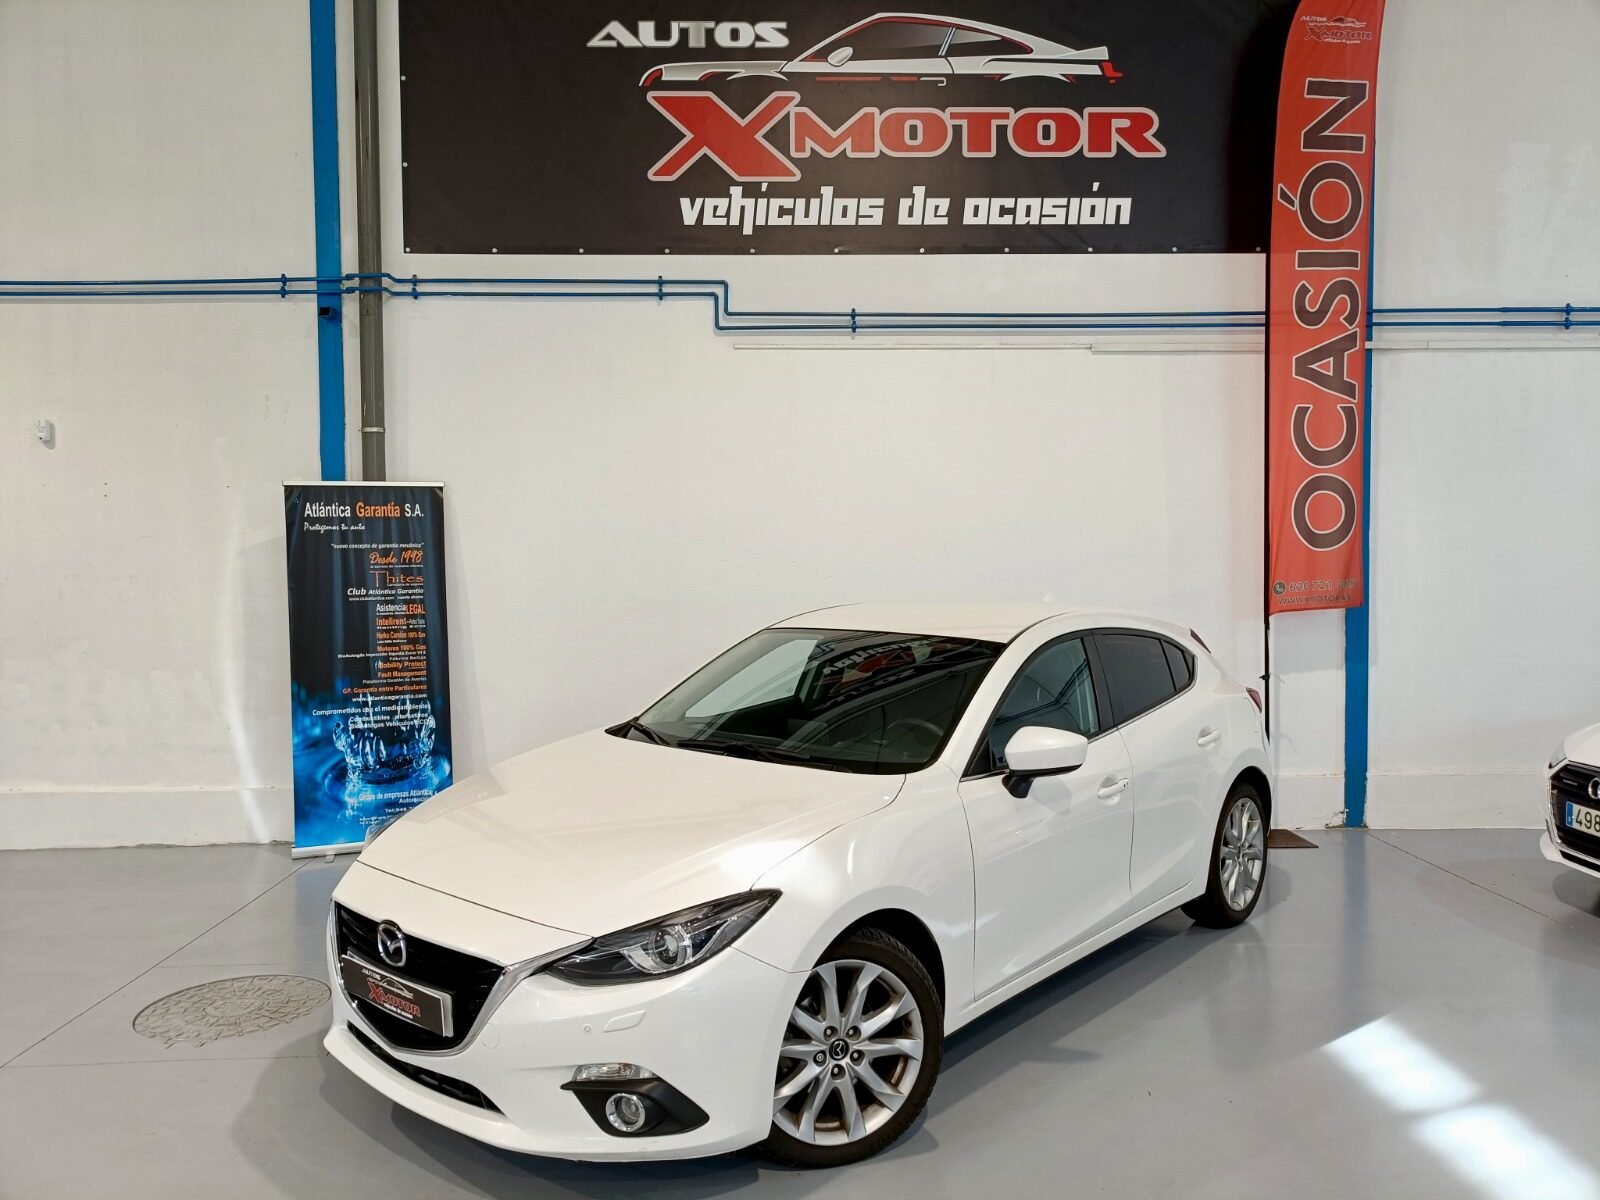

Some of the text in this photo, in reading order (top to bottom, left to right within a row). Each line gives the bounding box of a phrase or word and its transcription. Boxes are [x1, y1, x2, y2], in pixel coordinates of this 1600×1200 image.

[586, 20, 790, 48] AUTOS
[647, 91, 1167, 182] XMOTOR
[680, 182, 1132, 235] vehículos de ocasión
[1278, 78, 1369, 552] OCASIÓN
[304, 502, 424, 518] Atlántica Garantía S.A.
[304, 522, 366, 534] Protegemos tu auto
[369, 550, 423, 564] Desde 1998
[347, 587, 366, 596] Club
[393, 669, 427, 677] Management
[312, 707, 361, 716] Comprometidos
[384, 791, 409, 799] empresas
